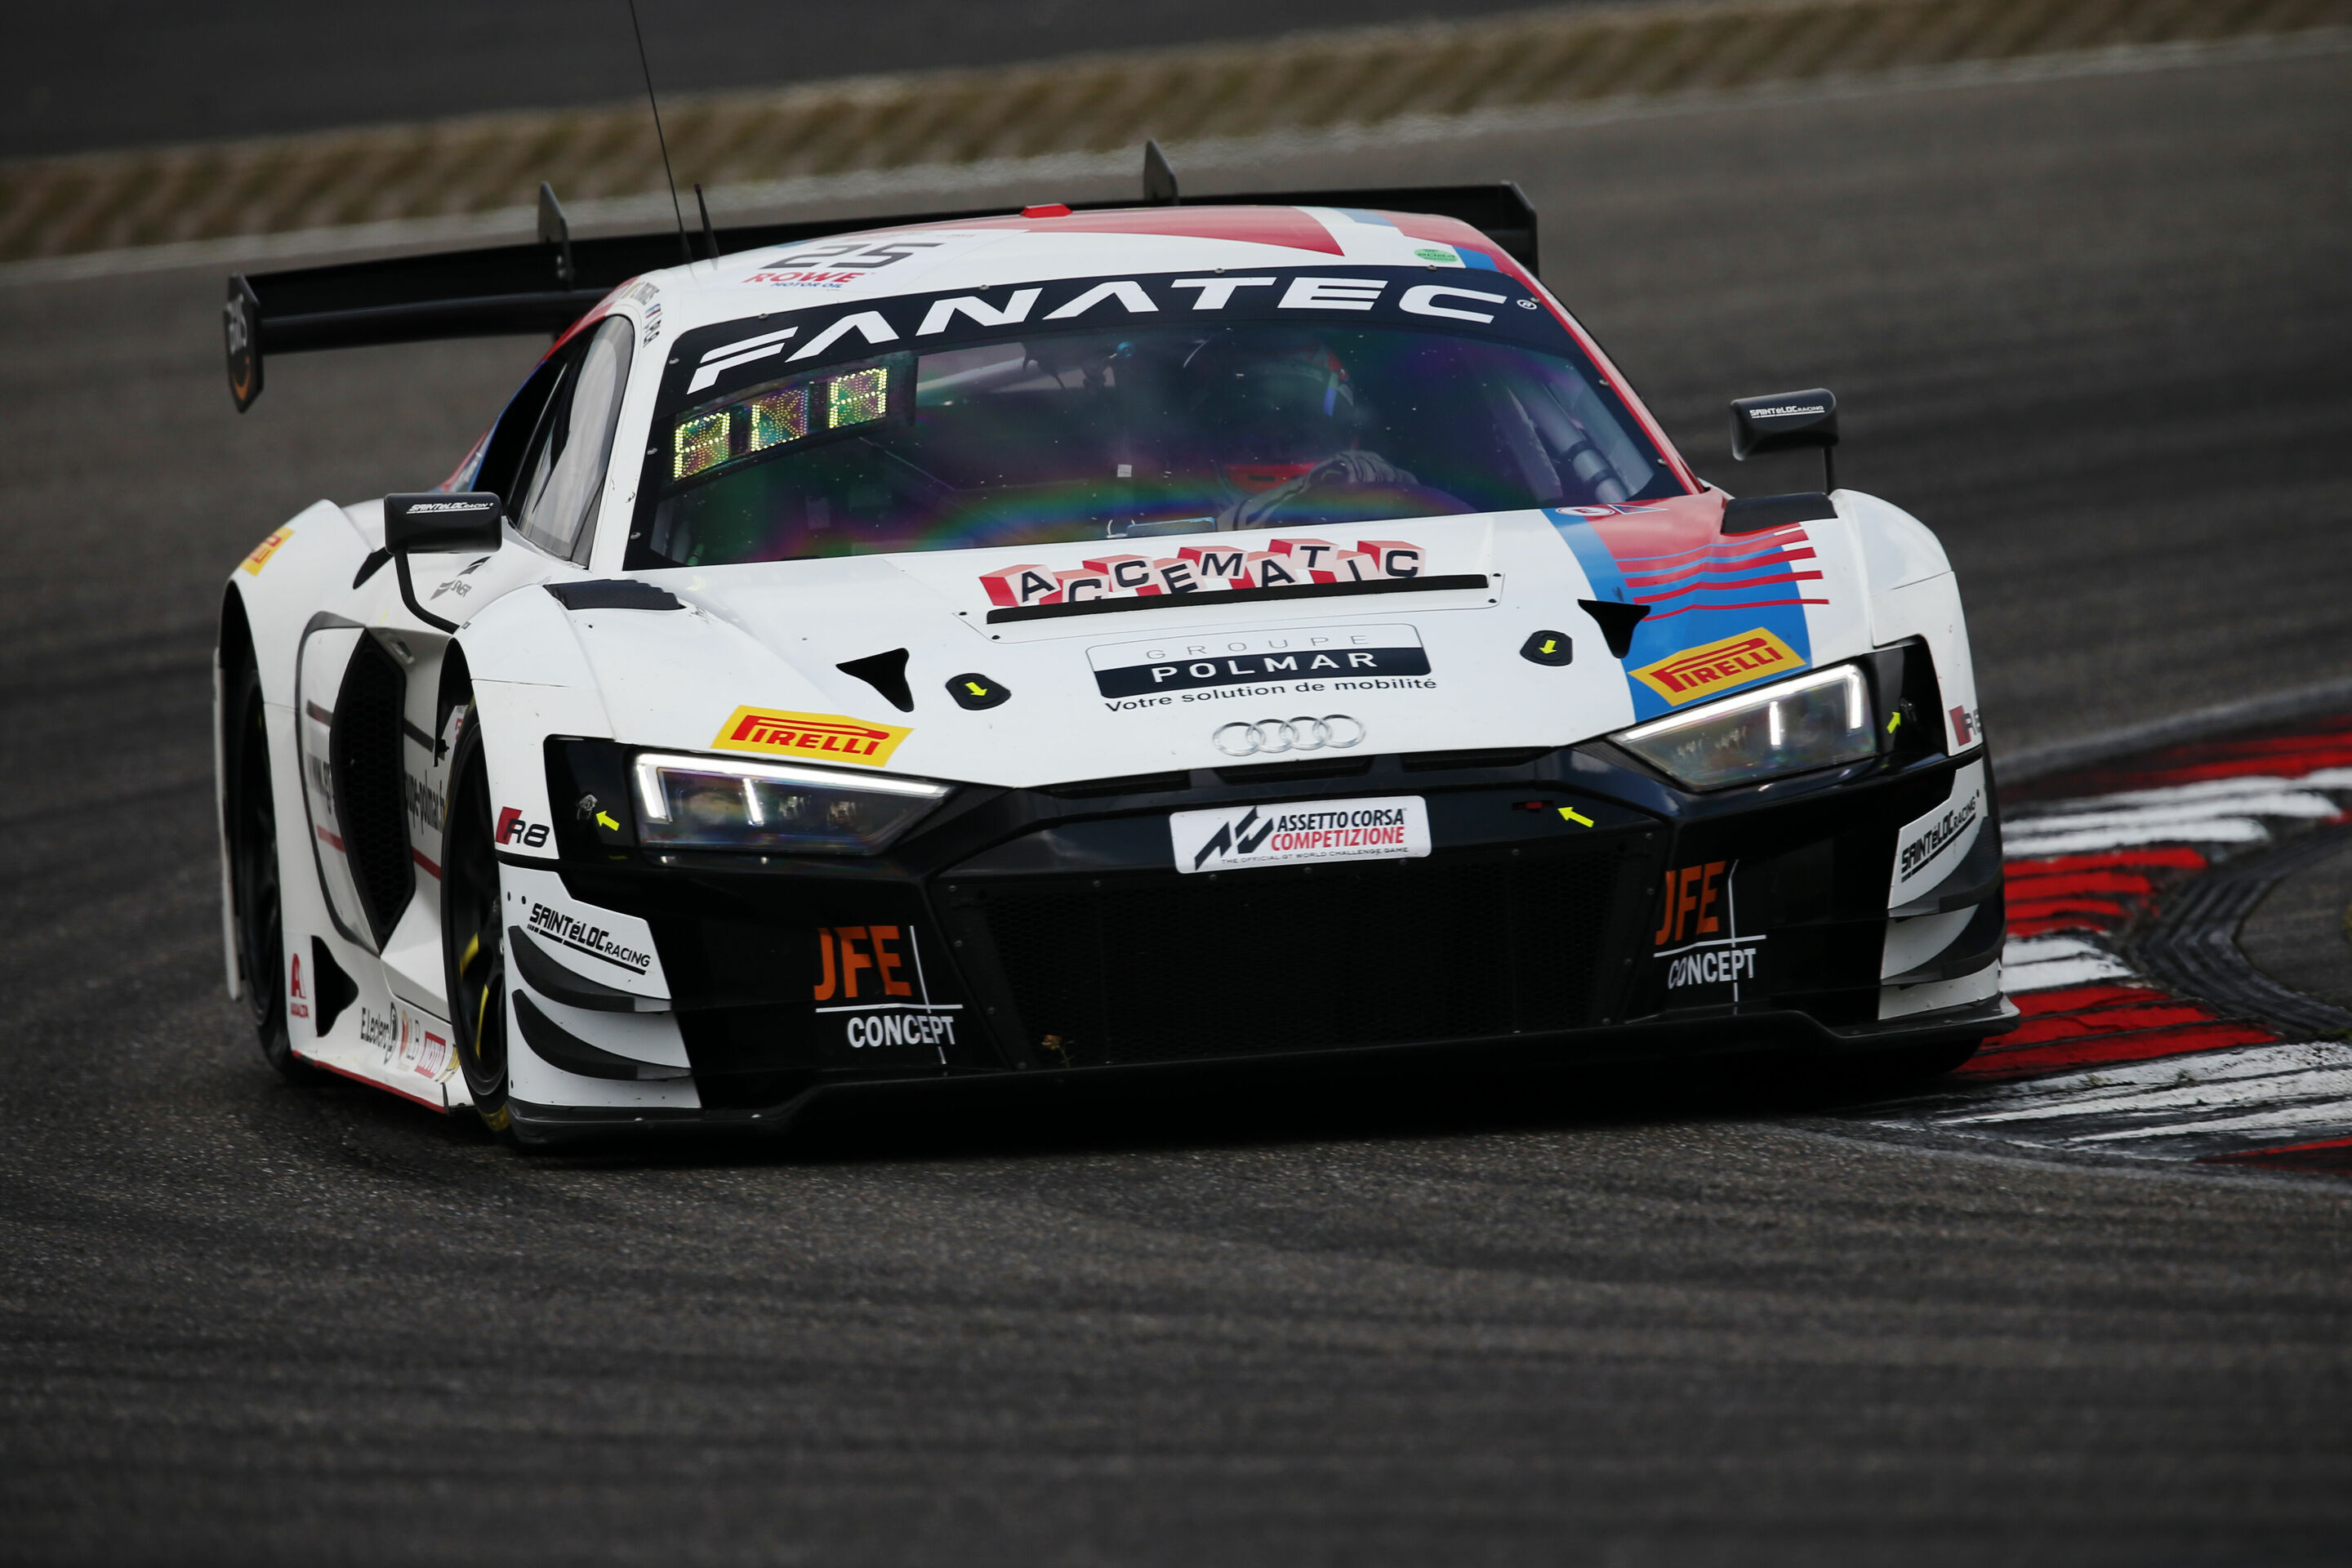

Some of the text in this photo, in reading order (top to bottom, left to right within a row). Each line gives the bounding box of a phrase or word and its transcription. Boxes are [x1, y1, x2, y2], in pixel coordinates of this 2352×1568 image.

[759, 242, 947, 270] 25
[742, 271, 866, 283] ROWE
[687, 275, 1508, 395] FANATEC
[1021, 546, 1419, 604] ACCEMATIC
[1146, 635, 1370, 660] GROUPE
[1649, 637, 1784, 693] PIRELLI
[1151, 653, 1379, 684] POLMAR
[1104, 677, 1438, 713] Votre solution de mobilité
[729, 715, 891, 756] PIRELLI
[502, 818, 550, 849] R8
[1276, 808, 1405, 832] ASSETTO CORSA
[1241, 853, 1281, 863] OFFICIAL
[1295, 851, 1326, 859] WORLD
[1328, 848, 1382, 858] CHALLENGE
[1383, 846, 1410, 854] GAME
[1271, 826, 1405, 851] COMPETIZIONE
[1655, 860, 1727, 946] JFE
[813, 925, 913, 1001] JFE
[1668, 947, 1757, 990] CONCEPT
[847, 1014, 956, 1049] CONCEPT
